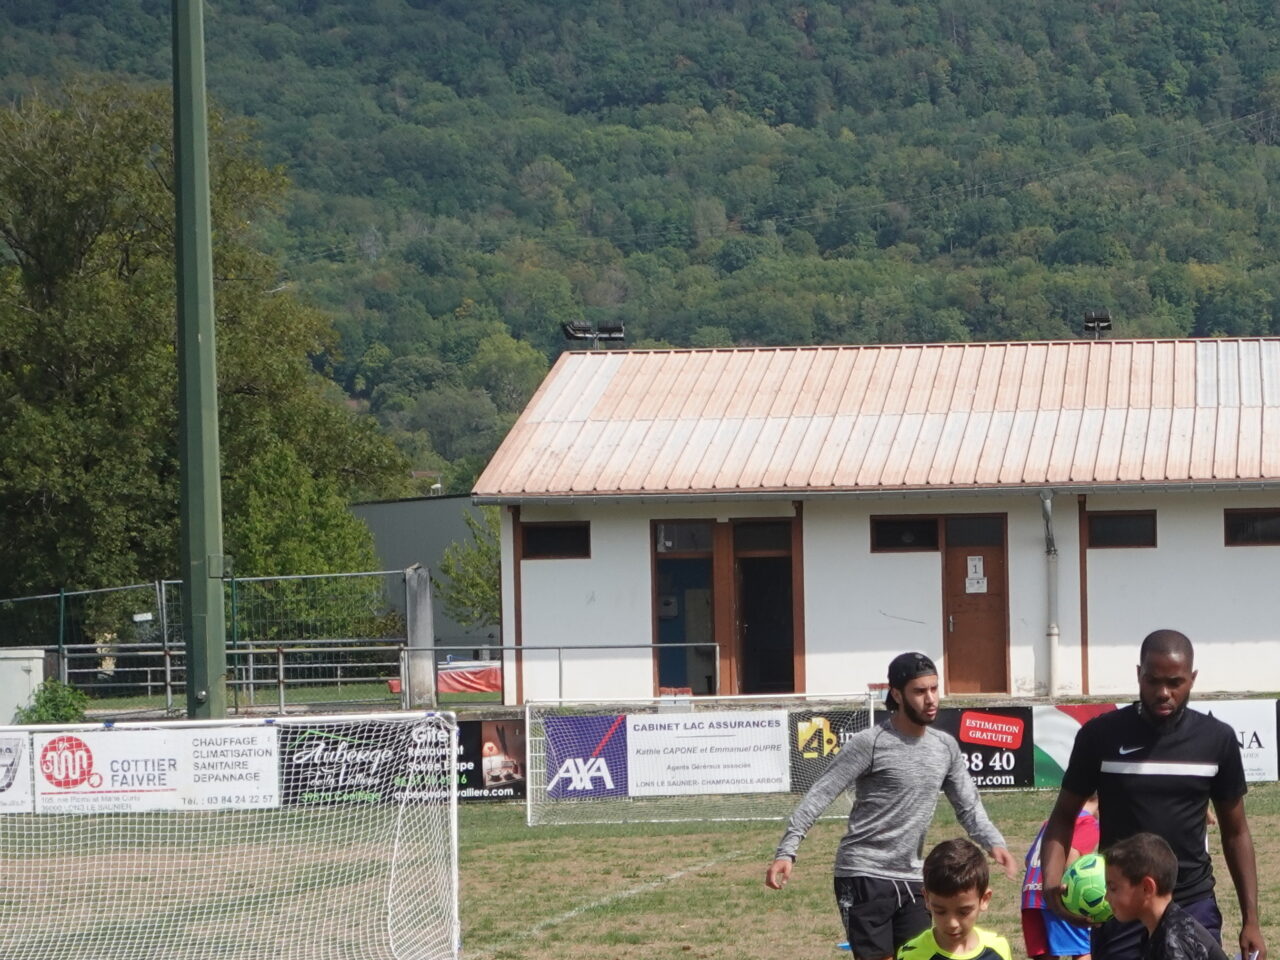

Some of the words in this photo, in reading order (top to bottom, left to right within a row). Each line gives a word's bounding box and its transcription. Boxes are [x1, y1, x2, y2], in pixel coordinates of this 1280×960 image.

[633, 722, 679, 731] CABINET
[683, 721, 704, 730] LAC
[708, 719, 781, 729] ASSURANCES
[966, 719, 1019, 734] ESTIMATION
[192, 737, 258, 747] CHAUFFAGE
[969, 730, 1013, 744] GRATUITE
[192, 748, 272, 759] CLIMATISATION
[663, 747, 698, 755] CAPONE
[709, 745, 751, 753] Emmanuel
[110, 758, 177, 773] COTTIER
[193, 761, 249, 771] SANITAIRE
[989, 752, 1015, 771] 40
[111, 773, 167, 787] FAIVRE
[546, 758, 615, 791] AXA
[970, 775, 1015, 786] er.com
[207, 796, 218, 805] 03
[221, 795, 232, 804] 84
[235, 795, 246, 804] 24
[263, 794, 273, 803] 57
